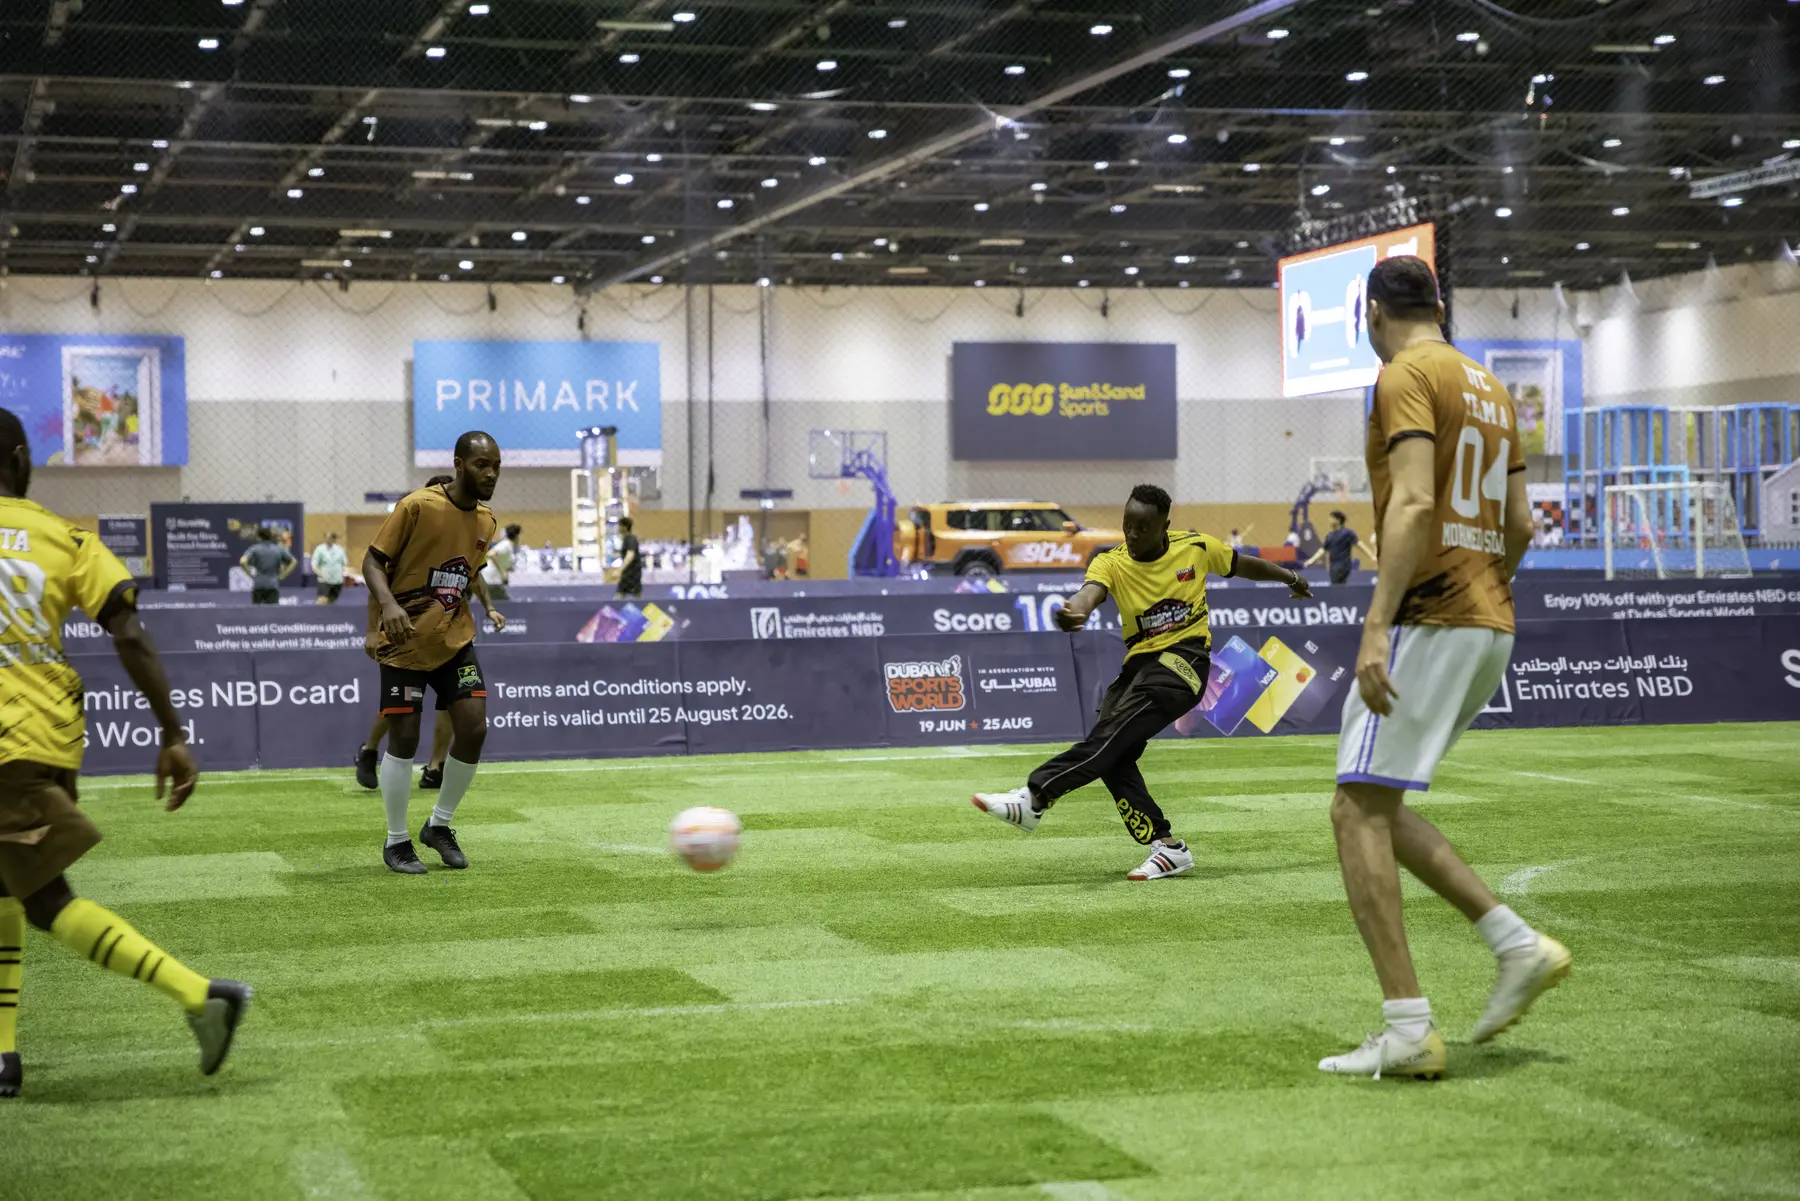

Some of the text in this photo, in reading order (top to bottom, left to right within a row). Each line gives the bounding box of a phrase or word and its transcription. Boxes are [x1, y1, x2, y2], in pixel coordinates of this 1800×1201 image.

[436, 379, 639, 412] PRIMARK
[1059, 400, 1110, 418] Sports
[1451, 426, 1510, 527] 04
[1544, 593, 1581, 610] Enjoy
[1582, 592, 1613, 607] 10%
[1614, 591, 1635, 606] off
[1636, 590, 1665, 606] with
[1666, 593, 1696, 608] your
[1697, 589, 1755, 605] Emirates
[1755, 588, 1786, 603] NBD
[933, 608, 1012, 632] Score
[1252, 606, 1301, 627] you
[1303, 601, 1365, 627] play.
[64, 622, 105, 638] NBD
[216, 623, 248, 635] Terms
[249, 623, 268, 635] and
[269, 622, 324, 635] Conditions
[783, 621, 885, 639] Emirates NBD
[195, 639, 213, 650] The
[214, 638, 240, 650] offer
[241, 638, 250, 650] is
[251, 638, 275, 649] valid
[276, 637, 298, 649] until
[314, 636, 348, 649] August
[886, 665, 940, 679] DUBAI
[1329, 665, 1346, 682] VISA
[1512, 654, 1688, 676] بنك الإمارات دبي الوطني
[889, 677, 961, 693] SPORTS
[1215, 668, 1232, 685] VISA
[1260, 668, 1278, 685] VISA
[210, 680, 283, 708] NBD
[289, 677, 360, 705] card
[494, 681, 552, 698] Terms
[555, 680, 590, 697] and
[592, 677, 693, 697] Conditions
[696, 676, 752, 696] apply.
[1515, 675, 1693, 700] Emirates NBD
[889, 692, 964, 710] WORLD
[493, 710, 540, 728] offer
[543, 709, 558, 727] is
[560, 708, 604, 726] valid
[607, 707, 646, 725] until
[648, 707, 672, 724] 25
[674, 704, 738, 726] August
[741, 703, 794, 721] 2026.
[919, 717, 1033, 732] 19 JUN 25 AUG
[96, 719, 205, 749] Word.
